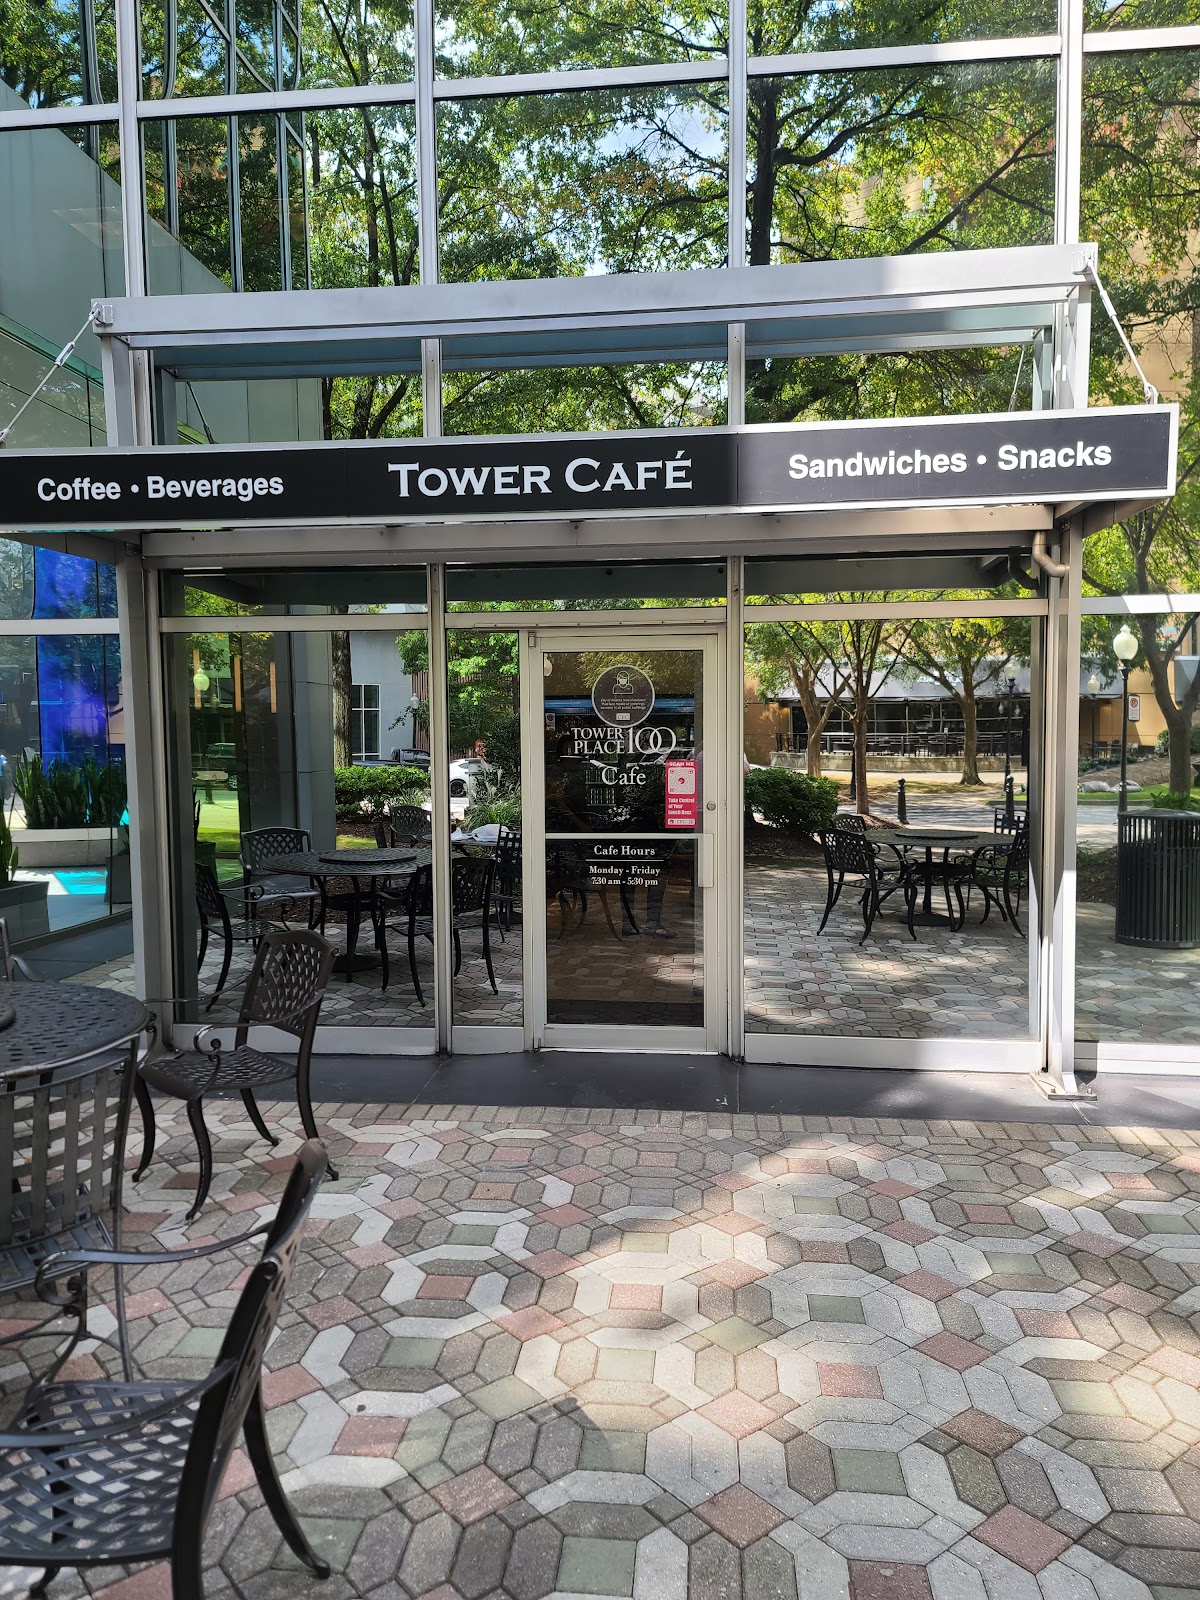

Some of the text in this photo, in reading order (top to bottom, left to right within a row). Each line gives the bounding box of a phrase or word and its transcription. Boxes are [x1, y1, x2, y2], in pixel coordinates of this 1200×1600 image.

[788, 449, 967, 479] Sandwiches
[997, 441, 1112, 471] Snacks
[387, 450, 693, 498] TOWER CAFÉ
[37, 476, 121, 501] Coffee
[147, 475, 284, 502] Beverages
[571, 727, 625, 740] TOWER
[626, 726, 677, 755] 100
[573, 740, 625, 754] PLACE
[601, 766, 646, 785] Cafe
[593, 845, 656, 856] Cafe Hours
[588, 865, 624, 877] Monday
[631, 866, 660, 876] Friday
[590, 876, 607, 886] 7:30
[626, 876, 644, 886] 5:30
[644, 878, 658, 888] pm
